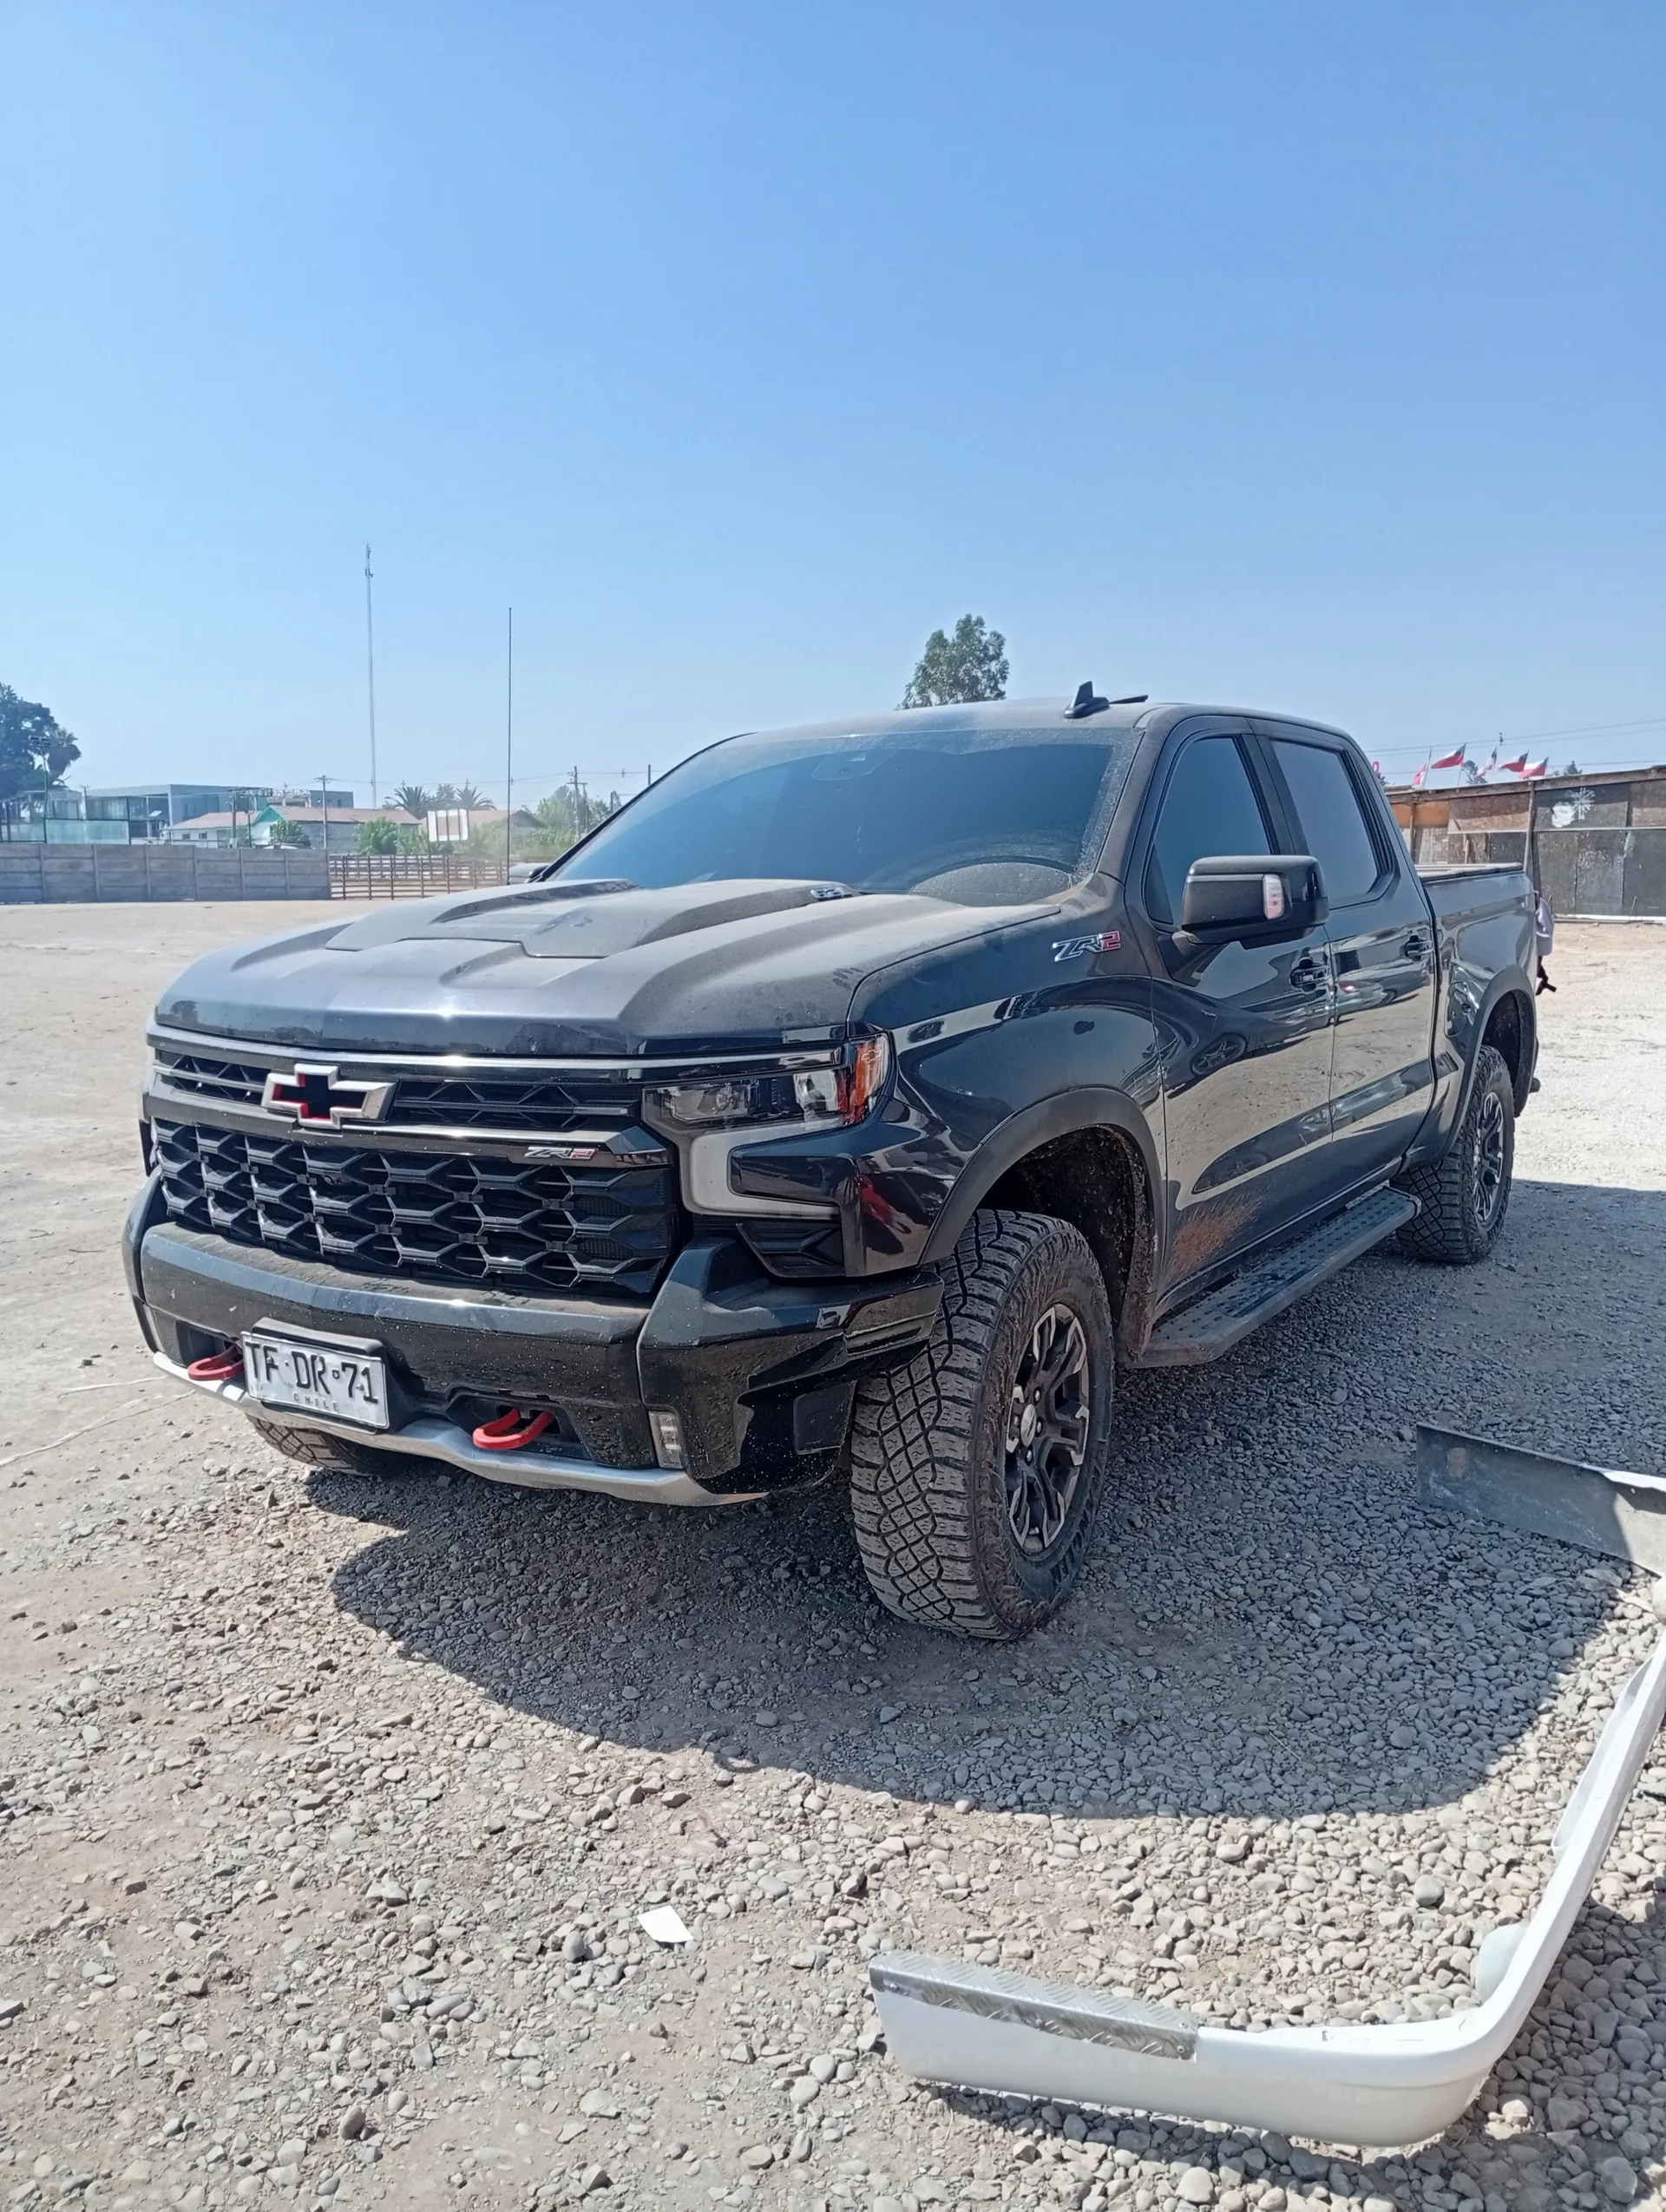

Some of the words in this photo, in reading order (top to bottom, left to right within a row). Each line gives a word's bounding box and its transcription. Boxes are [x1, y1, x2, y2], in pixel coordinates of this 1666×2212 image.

[1052, 930, 1121, 963] ZR2
[524, 1146, 596, 1160] ZR2
[293, 1392, 338, 1411] CHILE
